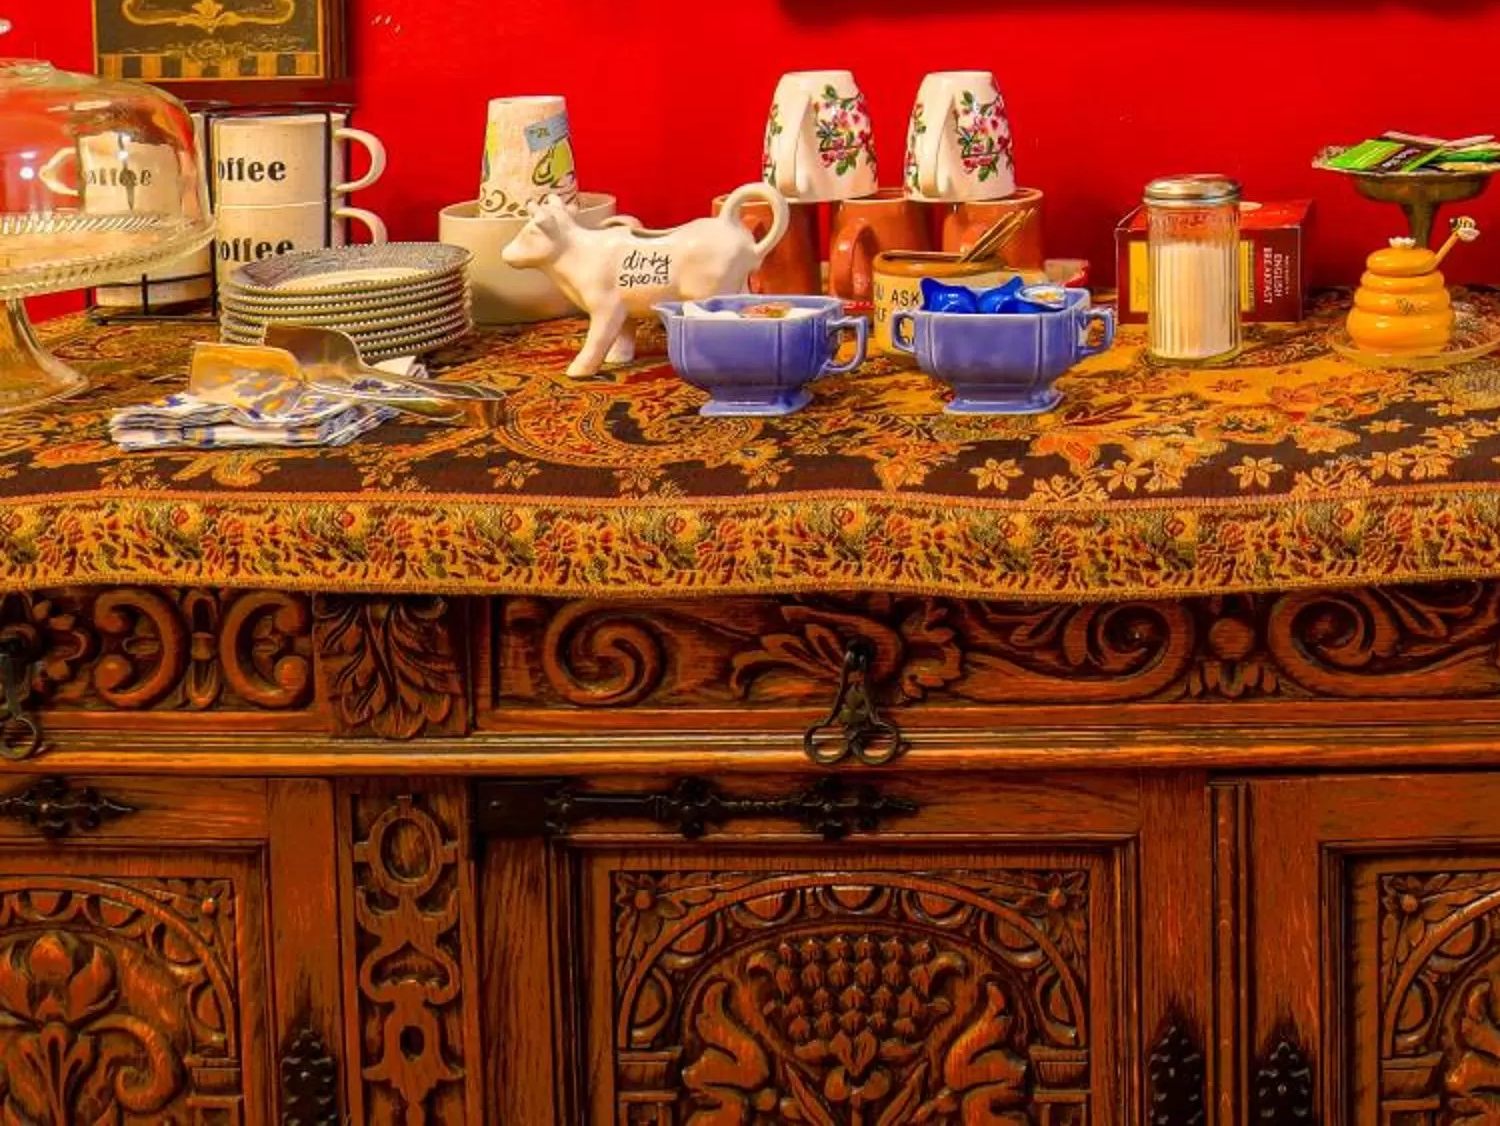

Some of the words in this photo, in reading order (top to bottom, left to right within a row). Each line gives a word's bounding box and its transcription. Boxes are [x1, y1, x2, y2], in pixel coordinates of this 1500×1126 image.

[622, 250, 672, 274] dirty
[619, 274, 670, 288] spoons
[1273, 253, 1283, 296] ENGLISH
[892, 289, 920, 307] ASK
